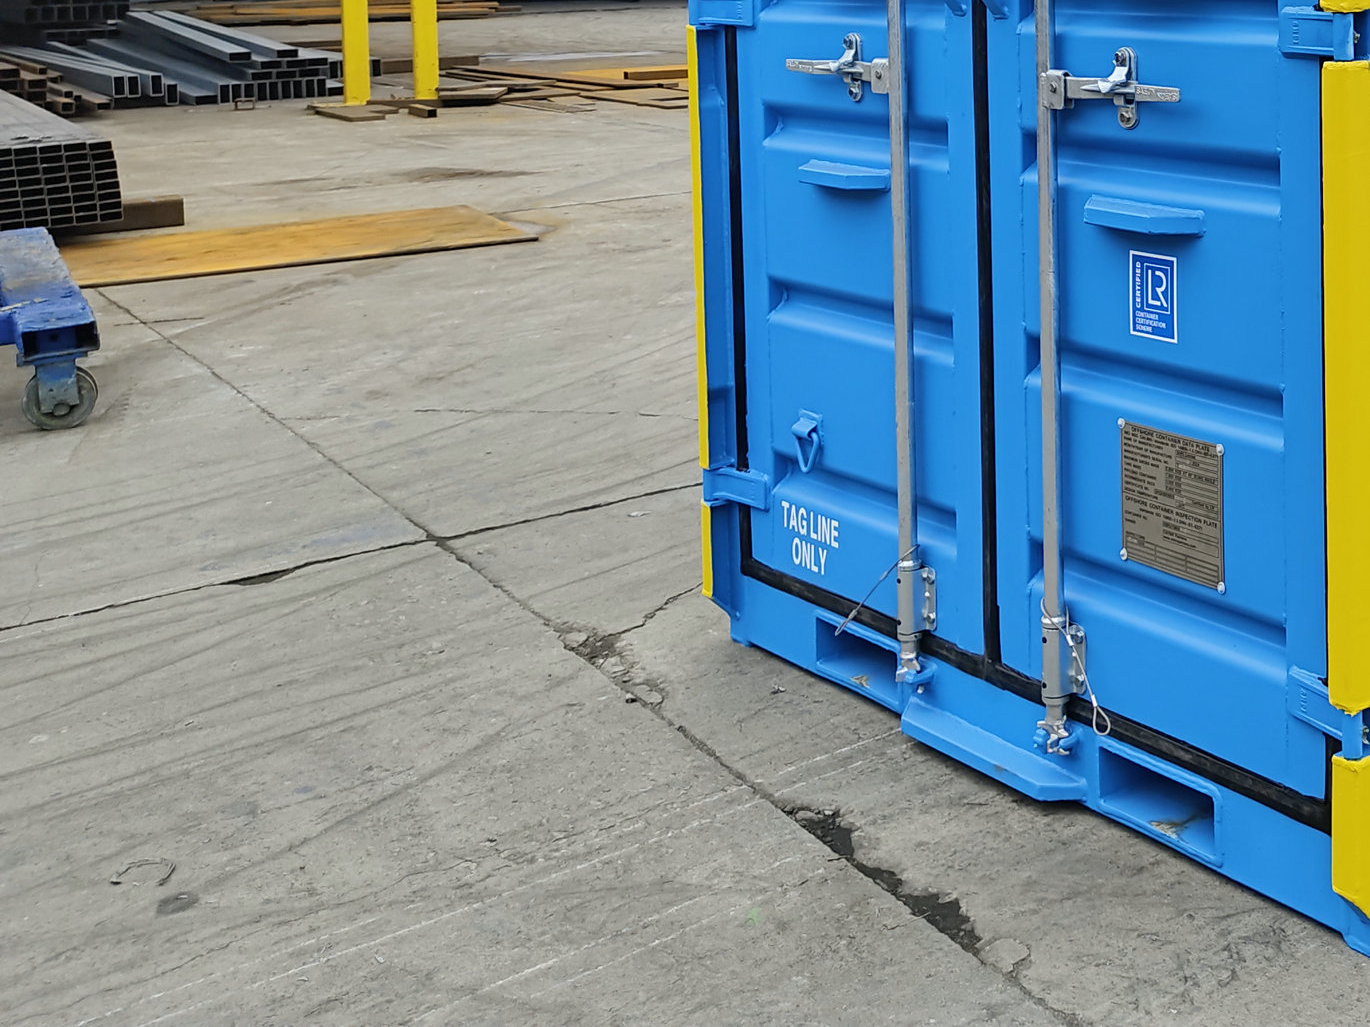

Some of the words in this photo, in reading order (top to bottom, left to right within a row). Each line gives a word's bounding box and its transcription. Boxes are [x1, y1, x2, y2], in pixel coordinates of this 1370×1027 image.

[781, 500, 807, 535] TAG
[810, 511, 839, 548] LINE
[792, 537, 827, 575] ONLY
